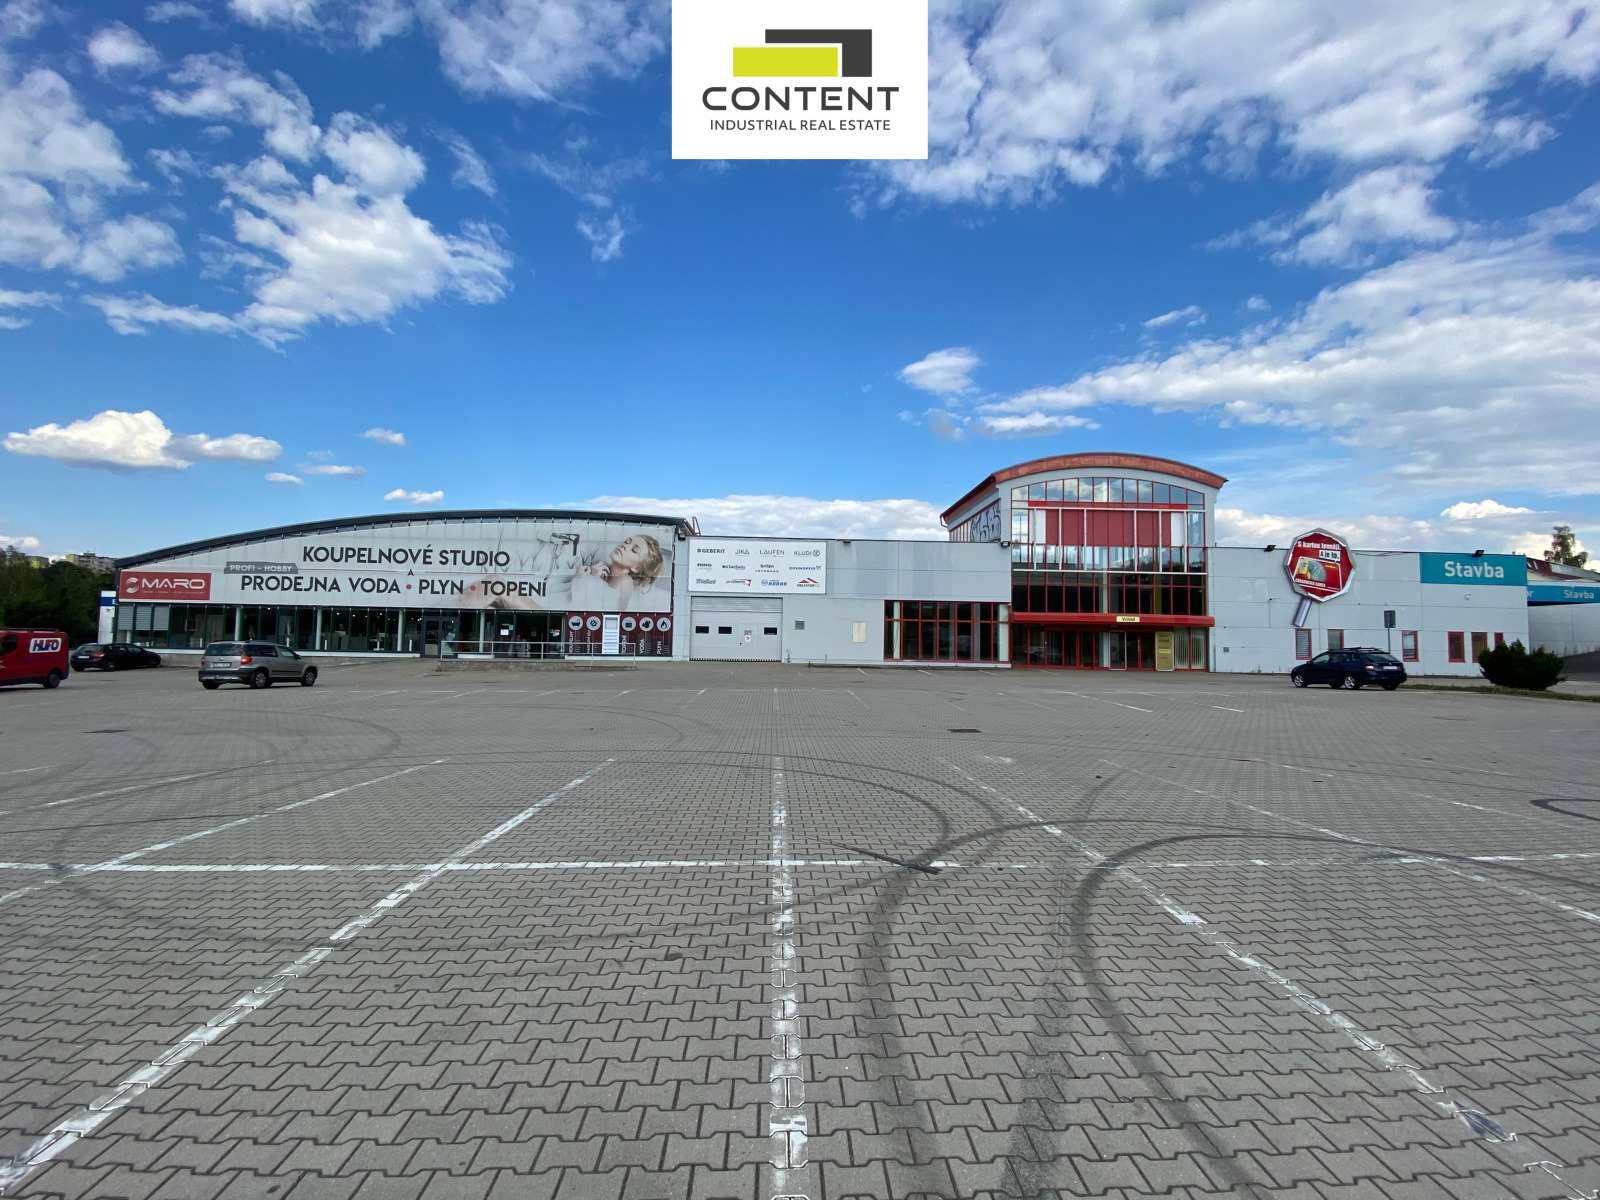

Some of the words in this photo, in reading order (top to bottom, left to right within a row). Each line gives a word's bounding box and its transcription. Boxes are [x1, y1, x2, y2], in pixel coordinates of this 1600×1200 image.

[303, 544, 433, 565] KOUPELNOVÉ
[439, 549, 510, 567] STUDIO
[230, 564, 255, 572] PROFI
[264, 564, 293, 573] HOBBY
[407, 569, 415, 577] A
[1444, 561, 1504, 578] Stavba
[142, 577, 206, 590] MARO
[241, 575, 341, 592] PRODEJNA
[349, 577, 401, 594] VODA
[418, 579, 464, 595] PLYN
[481, 576, 547, 597] TOPENÍ
[1563, 589, 1595, 599] Stavba
